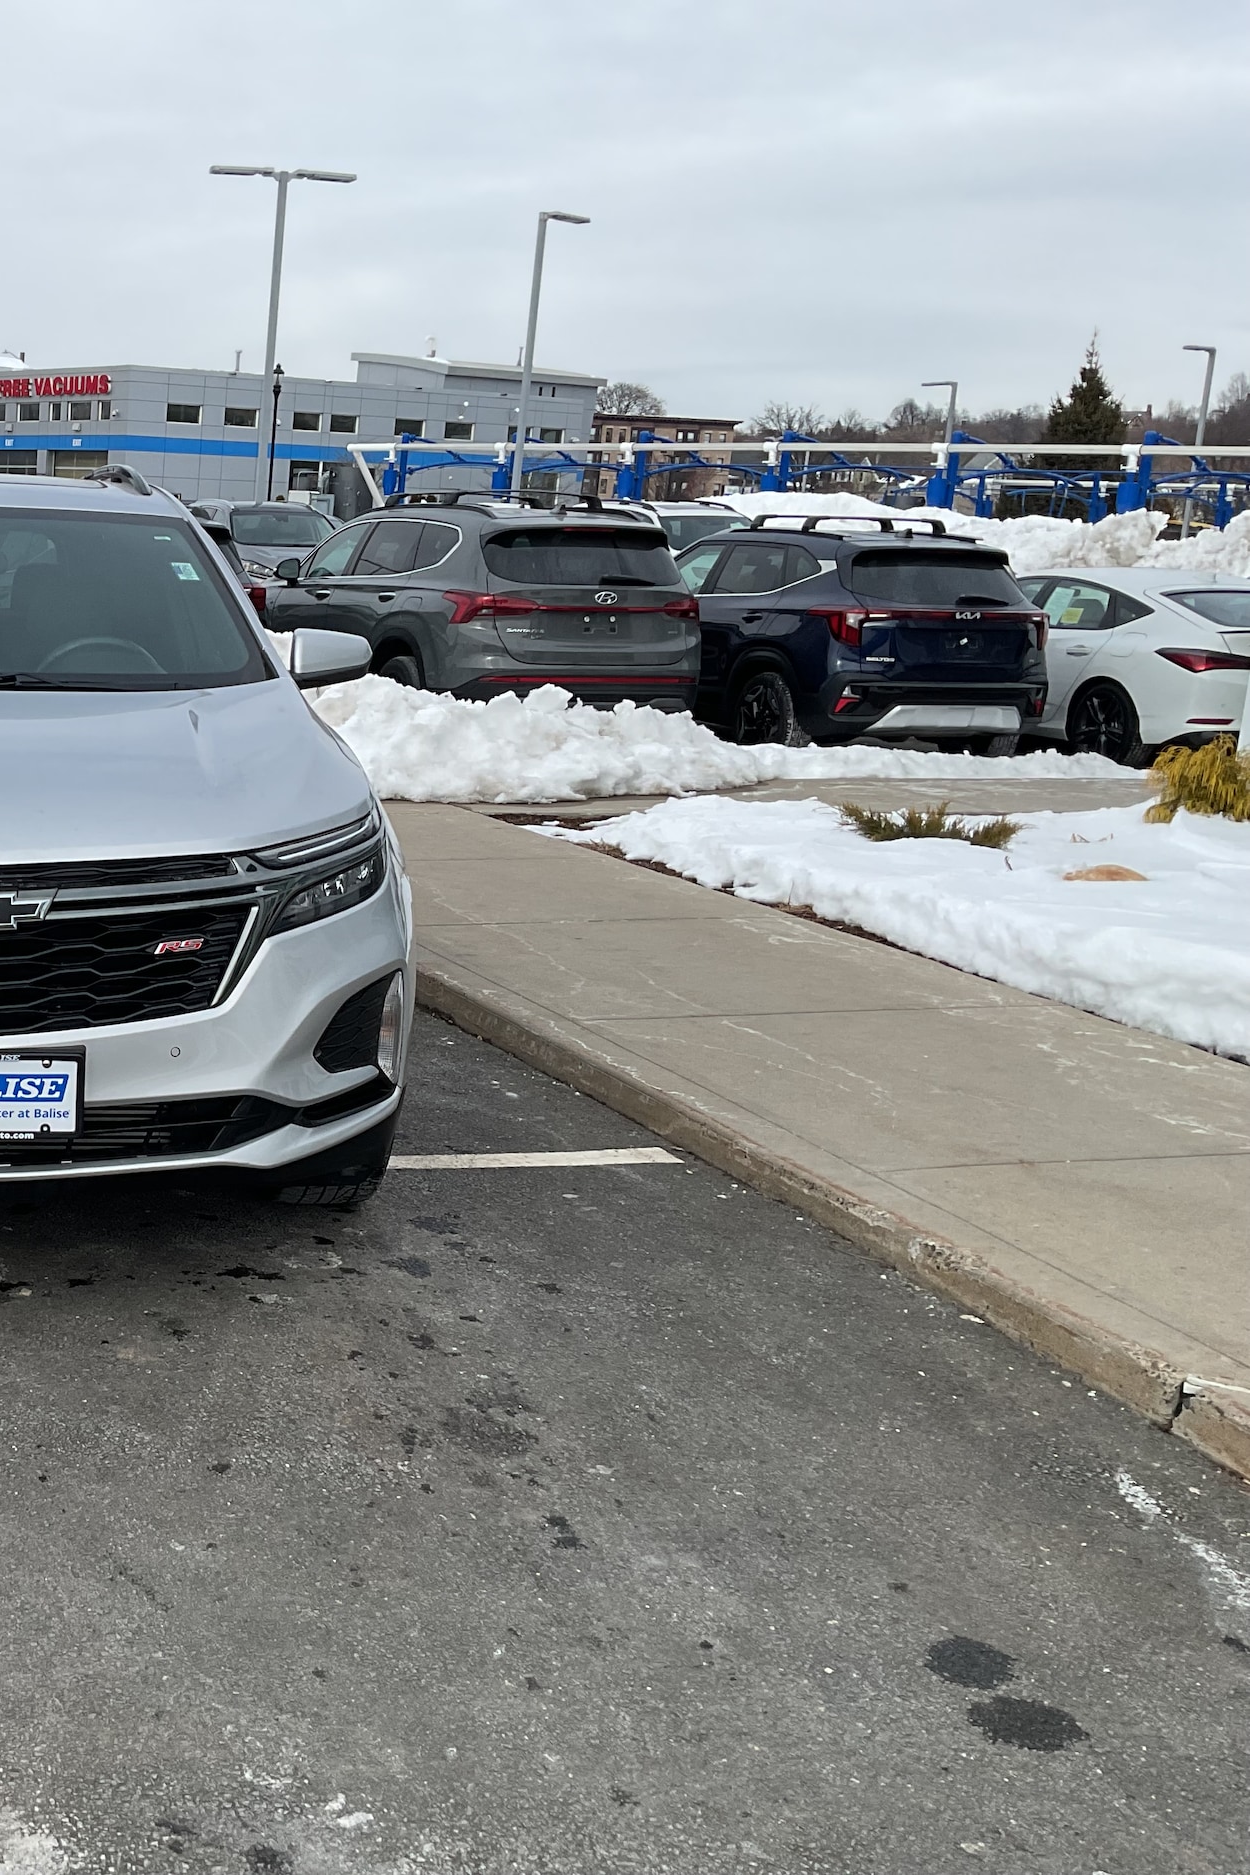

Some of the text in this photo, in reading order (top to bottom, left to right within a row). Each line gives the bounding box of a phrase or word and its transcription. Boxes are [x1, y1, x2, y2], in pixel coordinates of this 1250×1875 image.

[34, 375, 111, 396] VACUUMS
[154, 938, 204, 954] RS
[17, 1110, 30, 1118] at
[34, 1108, 70, 1118] Balise
